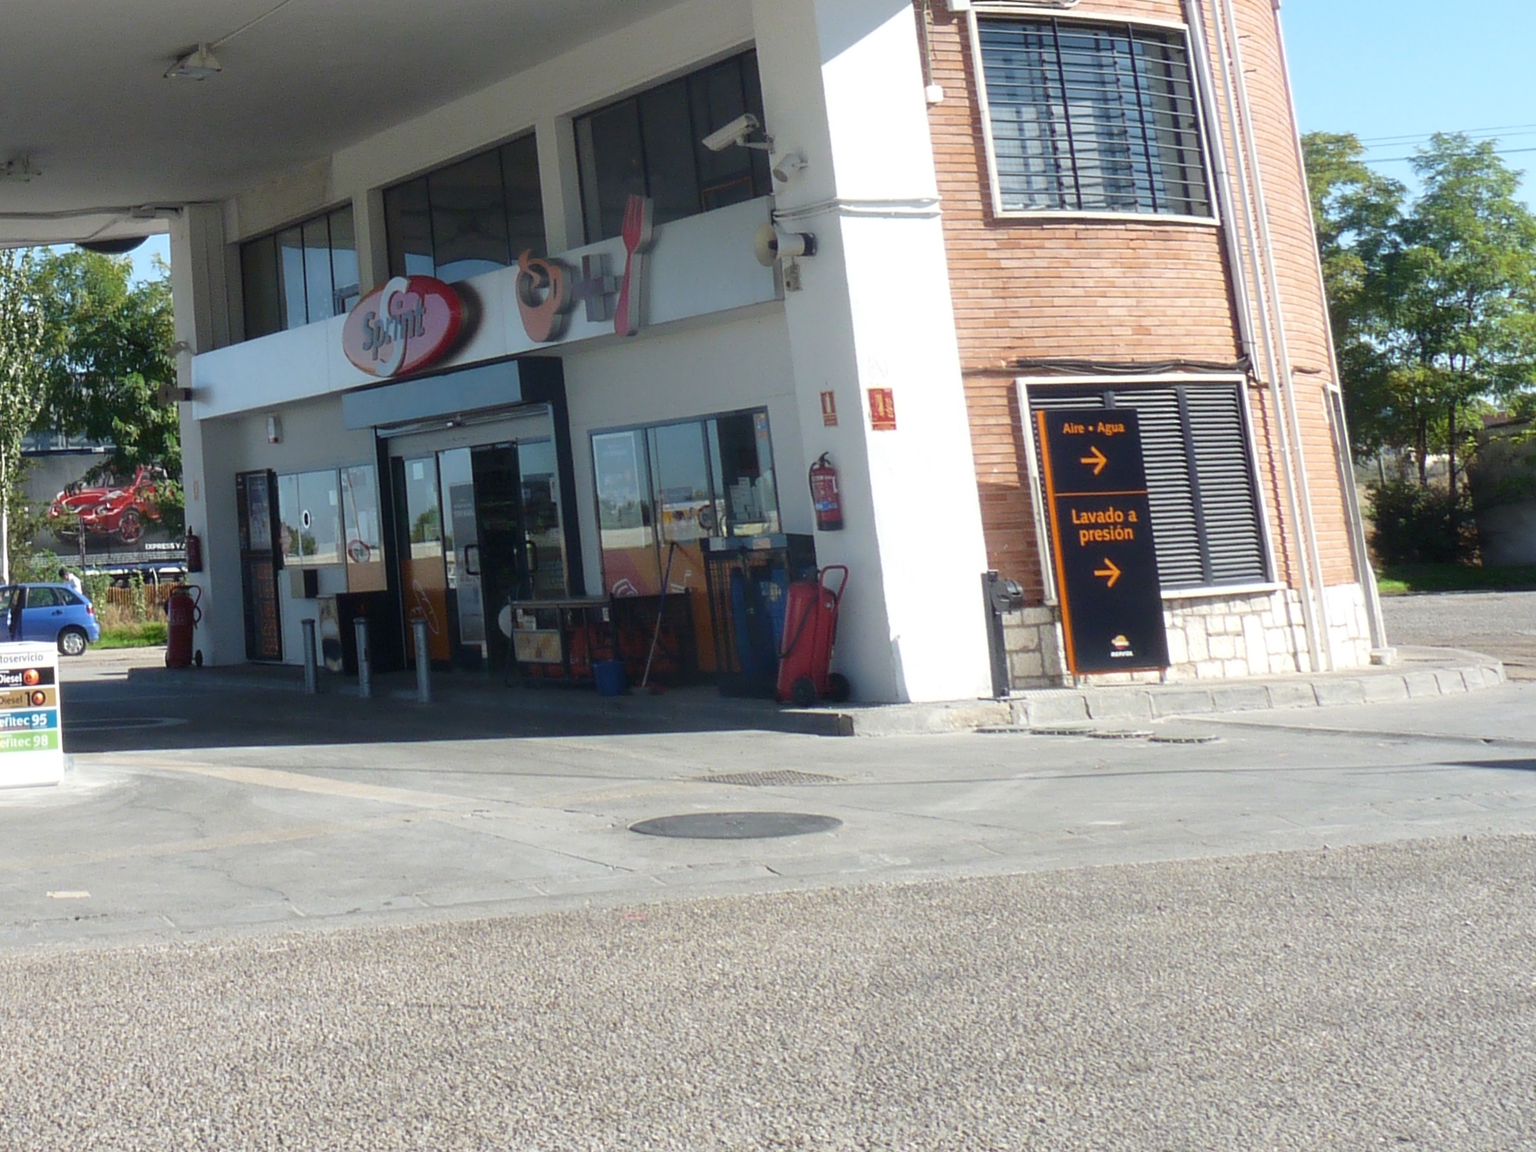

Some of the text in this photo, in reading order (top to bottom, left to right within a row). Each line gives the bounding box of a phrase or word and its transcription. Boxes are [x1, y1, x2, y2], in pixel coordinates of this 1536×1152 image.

[1063, 422, 1125, 436] Aire Agua
[1072, 506, 1138, 524] Lavado a
[1079, 526, 1134, 546] presión
[25, 690, 46, 707] 10
[32, 713, 47, 726] 95
[0, 734, 49, 748] efitec 98
